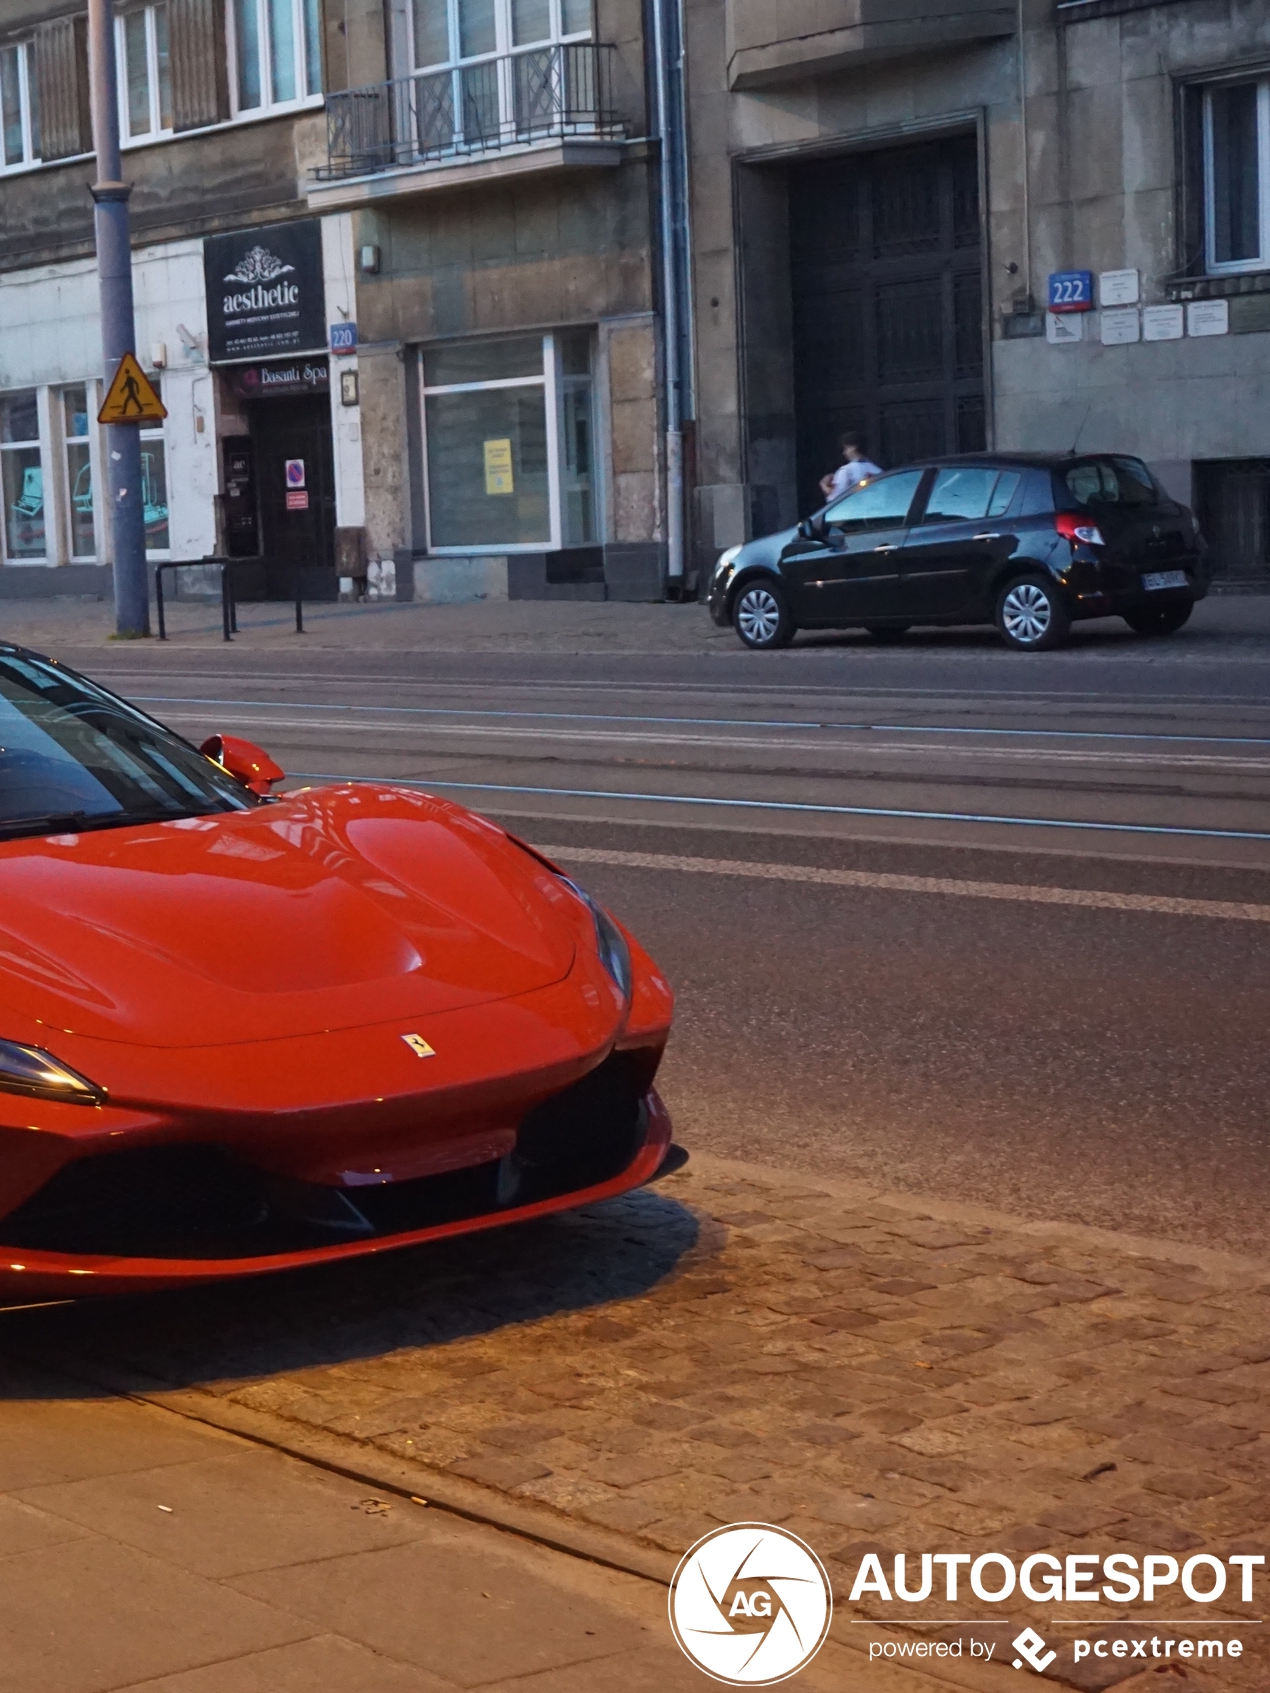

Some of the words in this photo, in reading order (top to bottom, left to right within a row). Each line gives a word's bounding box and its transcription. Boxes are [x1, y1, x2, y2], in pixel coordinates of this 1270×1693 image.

[223, 281, 299, 313] aesthetic
[1053, 280, 1084, 303] 222
[333, 329, 353, 347] 220
[262, 366, 300, 384] Basanti
[303, 363, 328, 385] Spa
